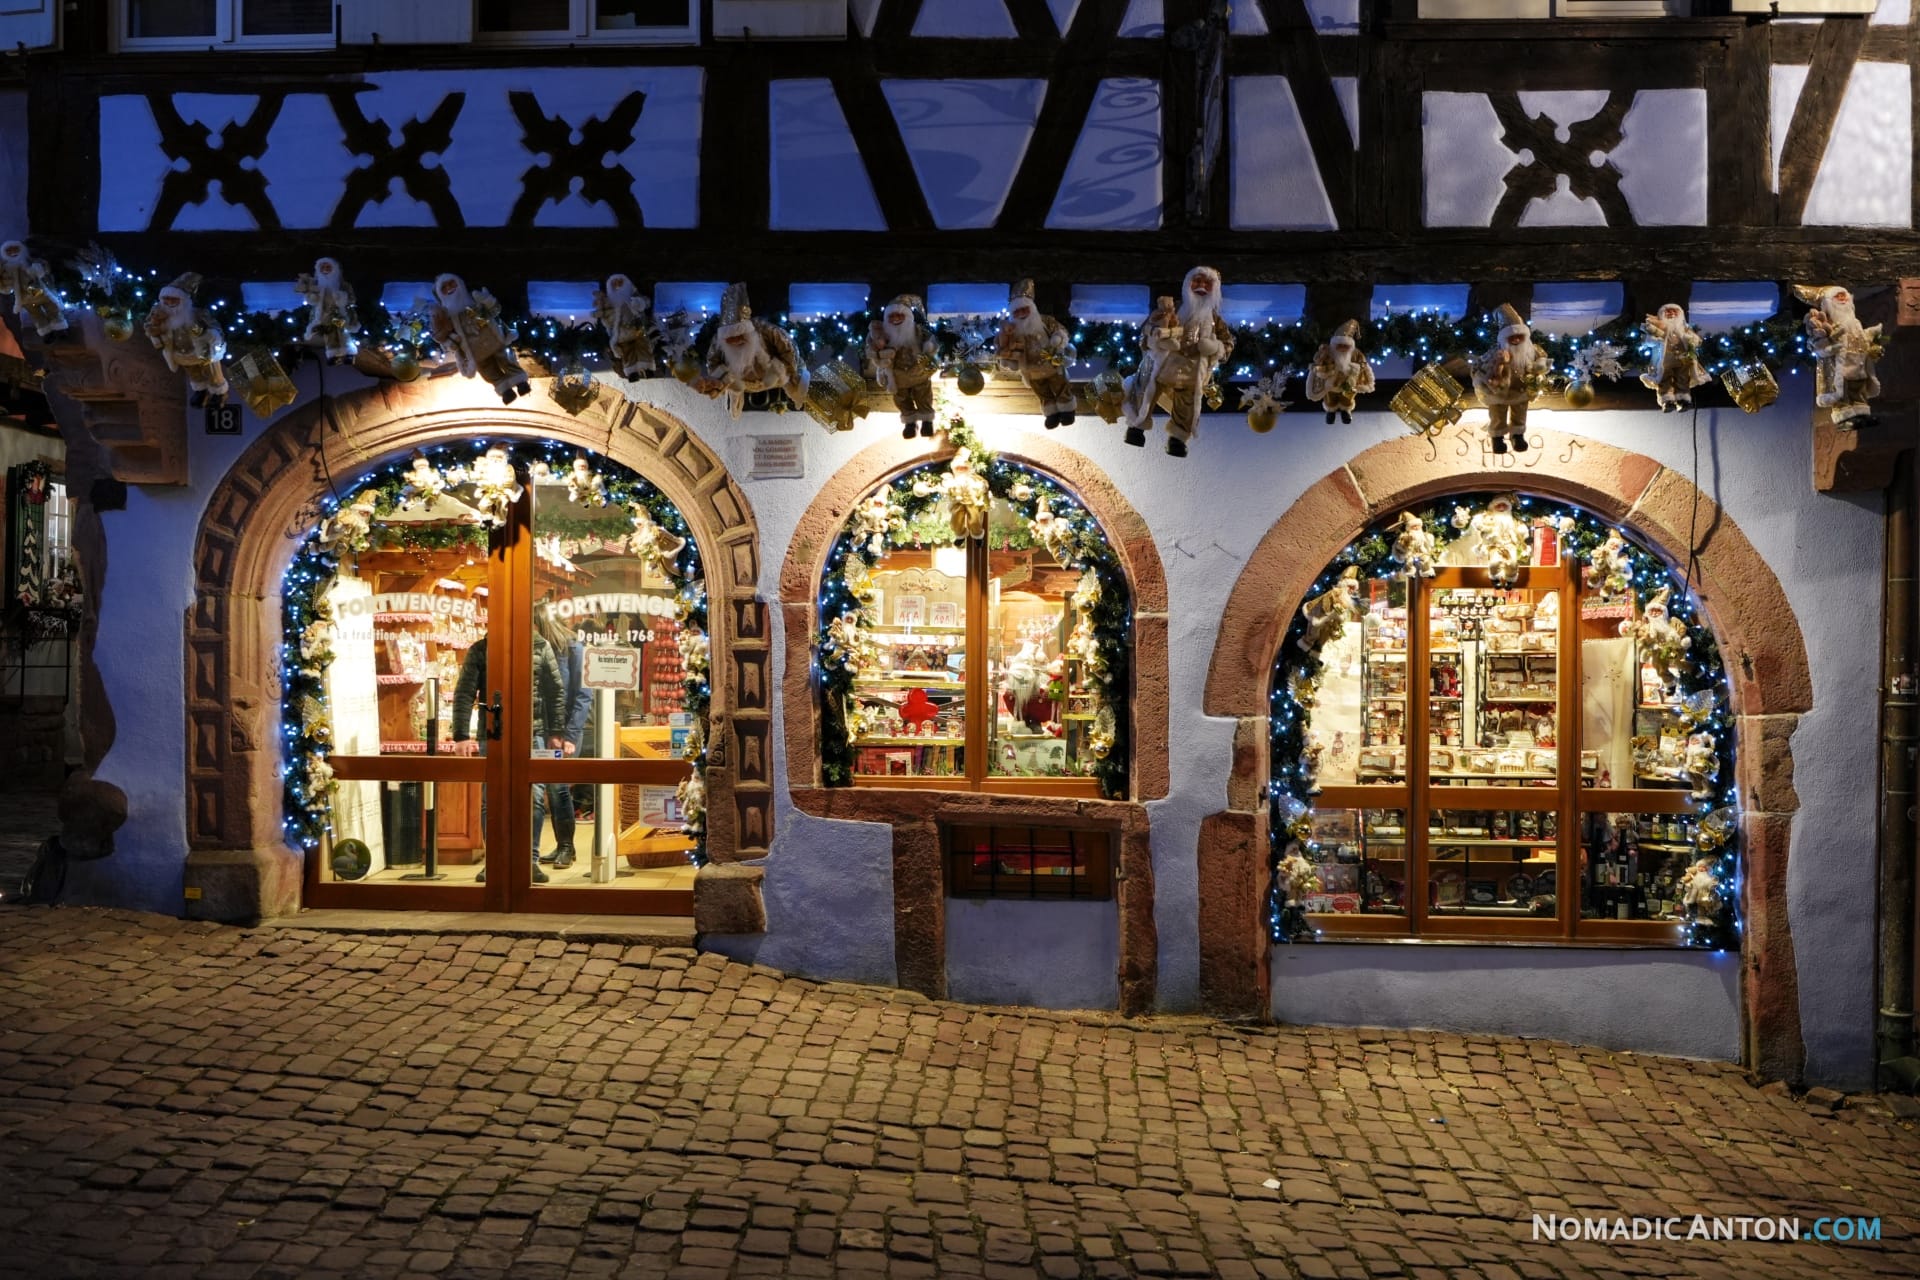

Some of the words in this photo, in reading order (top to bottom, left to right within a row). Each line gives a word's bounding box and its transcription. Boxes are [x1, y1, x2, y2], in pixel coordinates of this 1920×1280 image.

[211, 410, 234, 430] 18
[337, 592, 477, 619] FORTWENGER
[545, 593, 676, 621] FORTWENGE
[577, 629, 619, 645] Depuis
[627, 630, 655, 642] 1768
